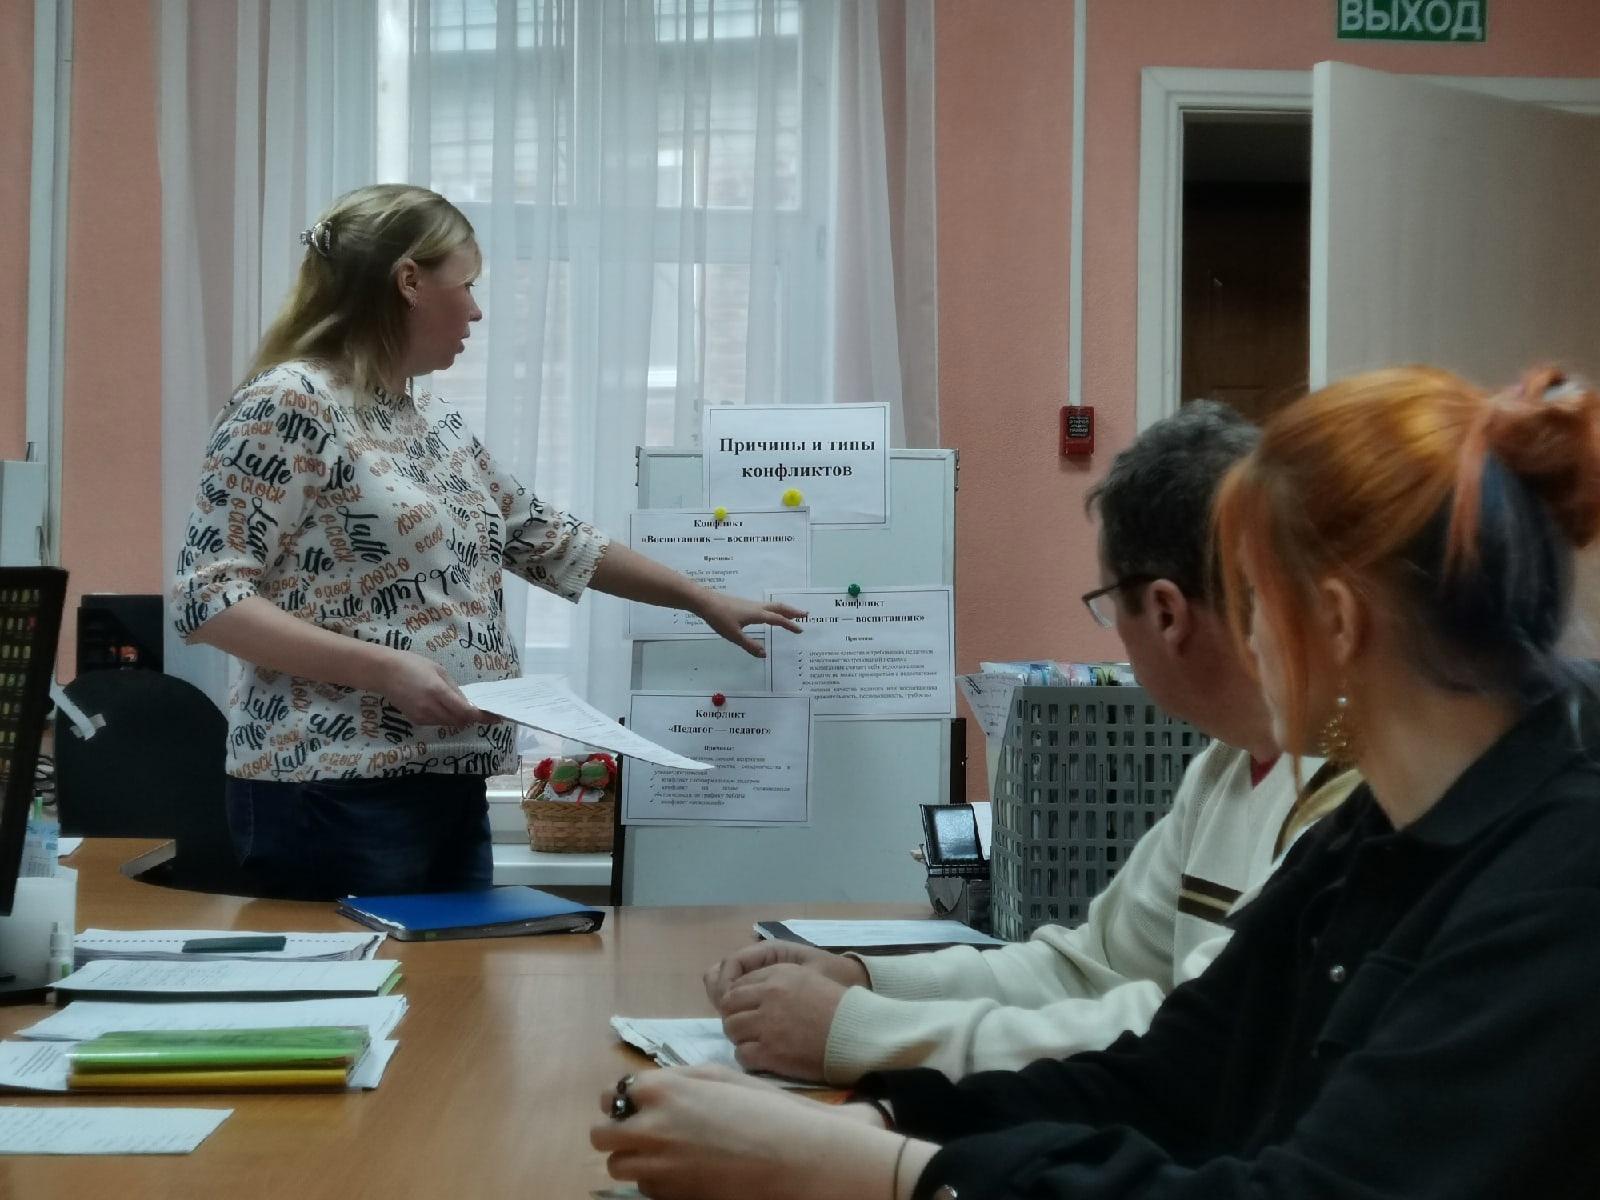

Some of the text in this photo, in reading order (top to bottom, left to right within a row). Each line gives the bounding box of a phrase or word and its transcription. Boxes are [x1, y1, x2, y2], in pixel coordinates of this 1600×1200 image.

[1341, 0, 1483, 40] ВЫХОД
[229, 397, 277, 424] Latte
[720, 438, 876, 456] Причины и типы
[222, 439, 293, 486] Latte
[742, 463, 853, 481] конфликтов
[335, 505, 391, 565] Latte
[445, 527, 479, 568] Latte
[370, 572, 427, 620] Latte
[834, 599, 885, 609] Конфликт
[240, 686, 290, 726] Latte
[695, 708, 747, 719] Конфликт
[306, 713, 358, 742] atte
[667, 724, 714, 734] «Педагог
[729, 724, 771, 735] педагог»
